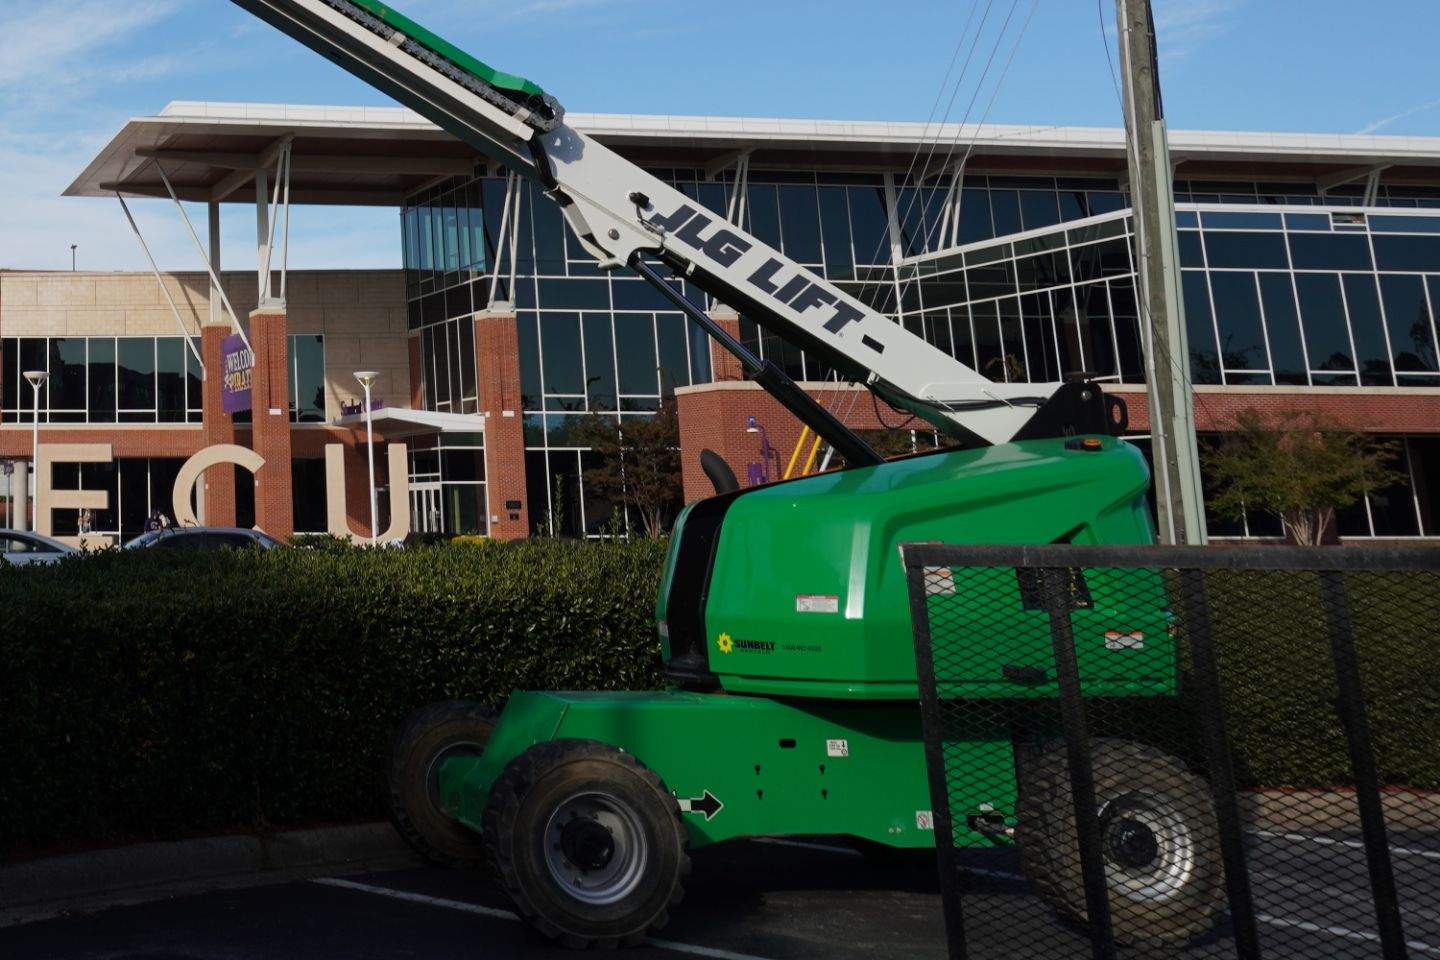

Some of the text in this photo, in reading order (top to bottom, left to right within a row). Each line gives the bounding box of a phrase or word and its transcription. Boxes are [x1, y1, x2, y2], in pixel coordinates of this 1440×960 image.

[650, 203, 866, 334] JLG LIFT
[36, 443, 410, 547] ECU
